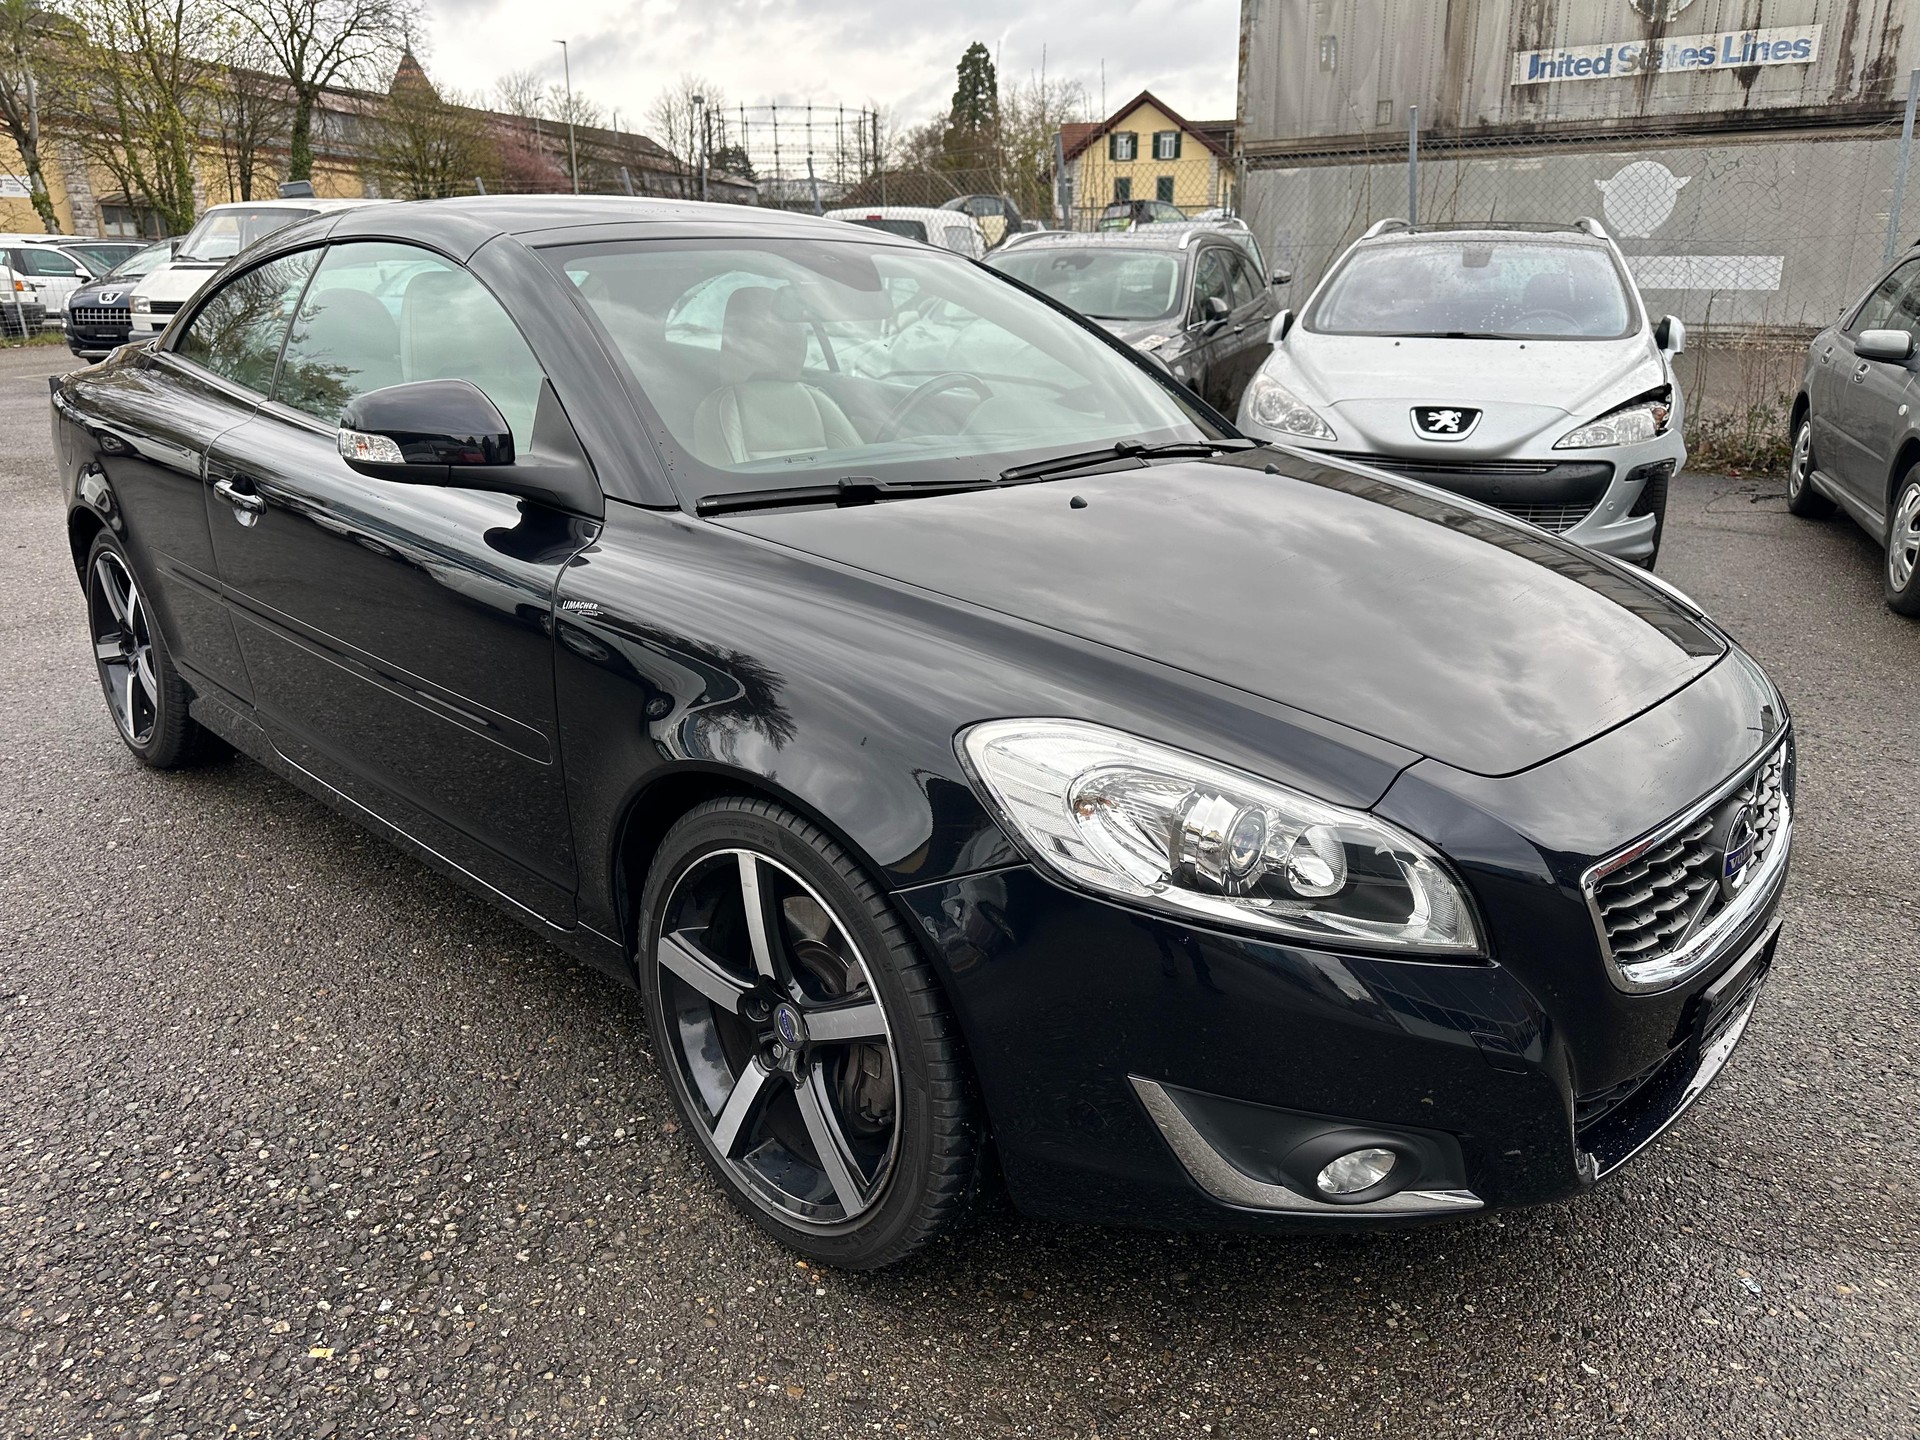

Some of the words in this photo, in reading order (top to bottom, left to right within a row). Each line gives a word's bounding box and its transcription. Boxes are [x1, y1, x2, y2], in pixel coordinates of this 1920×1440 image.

[1721, 32, 1811, 64] Lines
[562, 600, 599, 610] LIMACHER
[1729, 842, 1754, 868] VOLV
